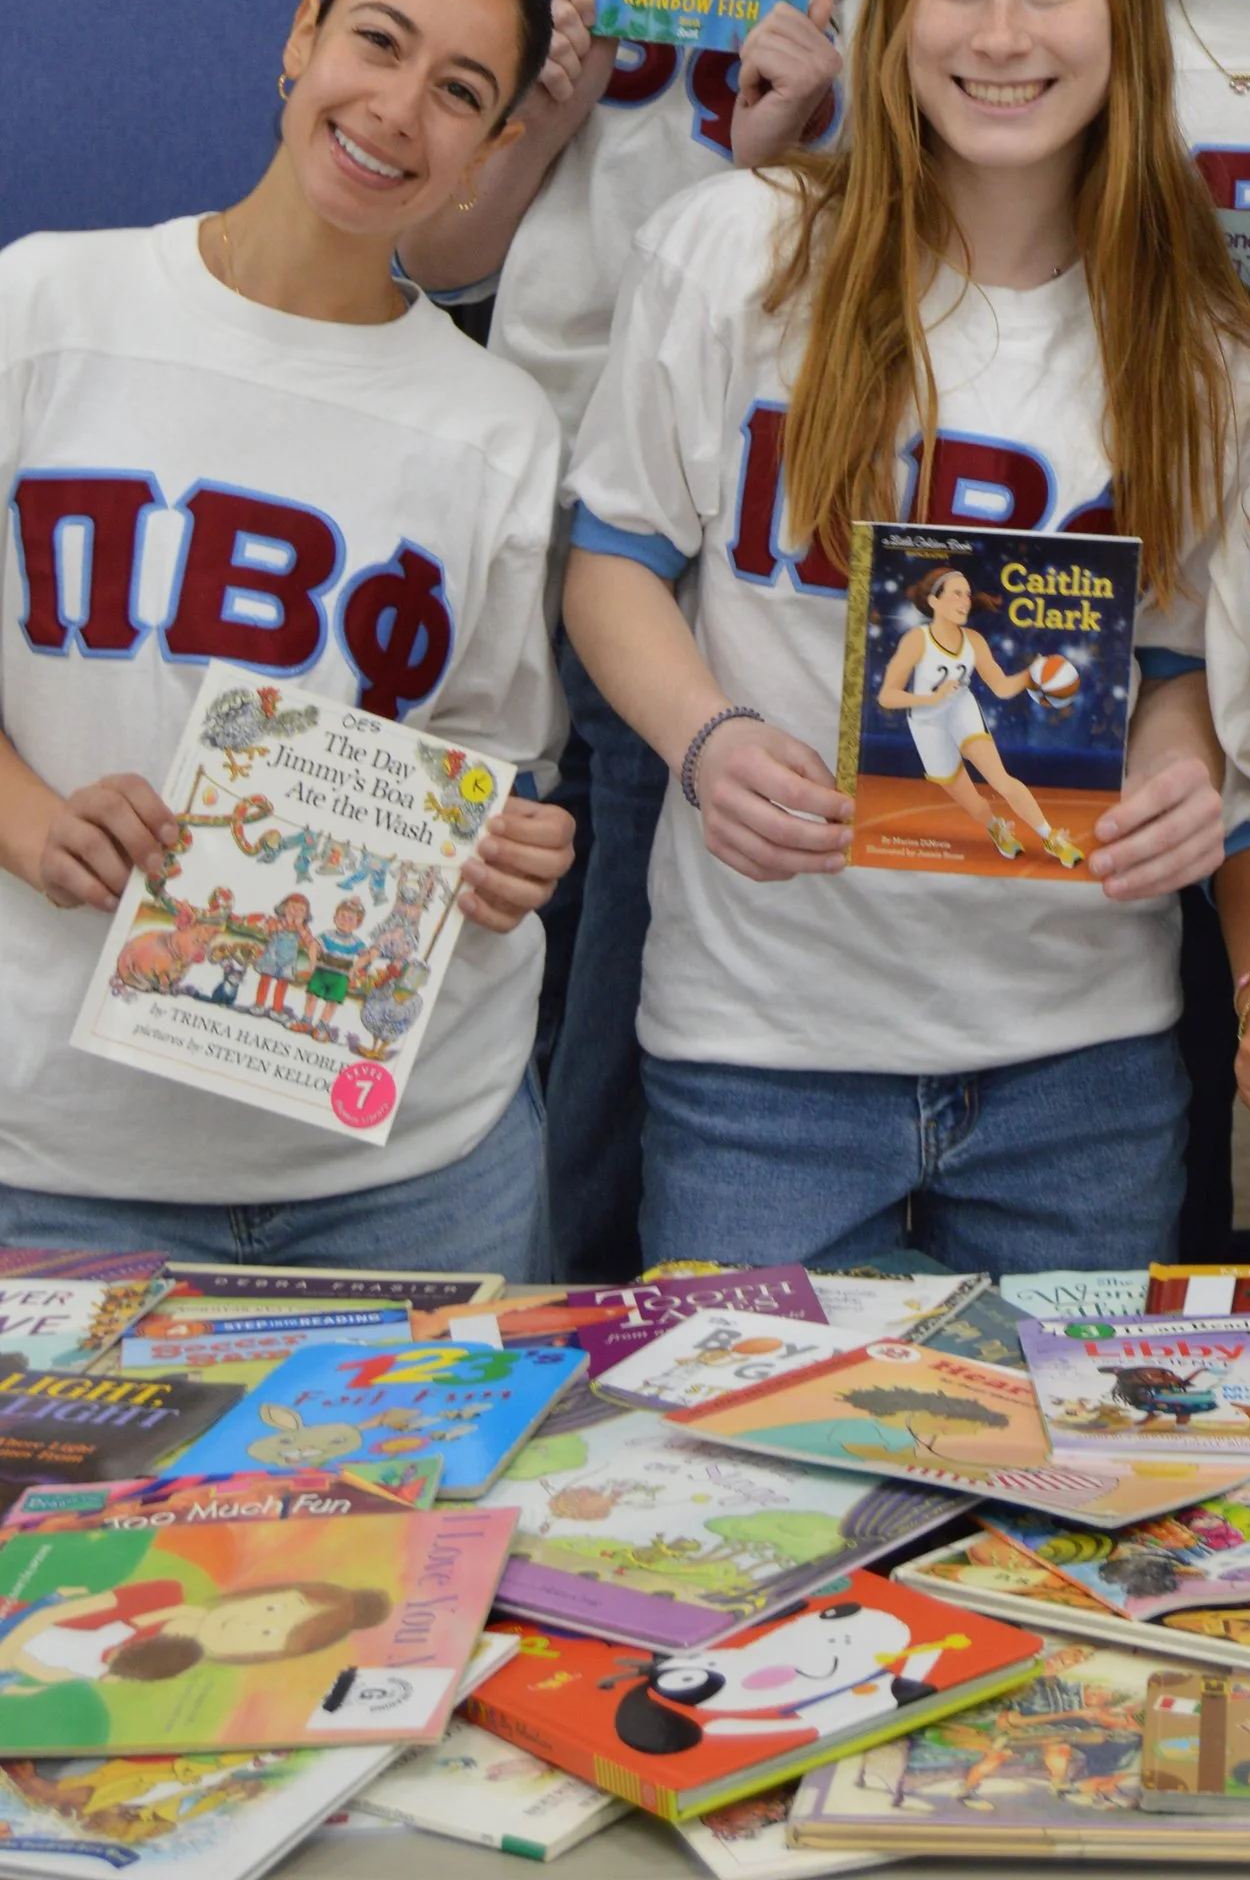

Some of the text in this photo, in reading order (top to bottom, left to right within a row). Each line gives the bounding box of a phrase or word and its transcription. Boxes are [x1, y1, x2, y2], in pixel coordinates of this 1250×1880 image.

[1000, 562, 1114, 599] Caitlin
[1007, 596, 1103, 632] Clark
[325, 731, 417, 784] The Day
[268, 743, 415, 811] Jimmy's Boa
[285, 779, 435, 847] Ate the Wash
[133, 1022, 185, 1049] pictures
[186, 1037, 203, 1056] by
[205, 1041, 272, 1074] STEVEN
[150, 1001, 168, 1019] by
[171, 1006, 232, 1041] TRINKA
[236, 1029, 292, 1059] HAKES
[355, 1080, 374, 1110] 7
[214, 1276, 307, 1290] DEBRA
[223, 1320, 267, 1332] STEP
[299, 1313, 381, 1327] READING
[1084, 1340, 1245, 1360] Libby
[187, 1497, 284, 1524] Much
[291, 1493, 352, 1515] Fun
